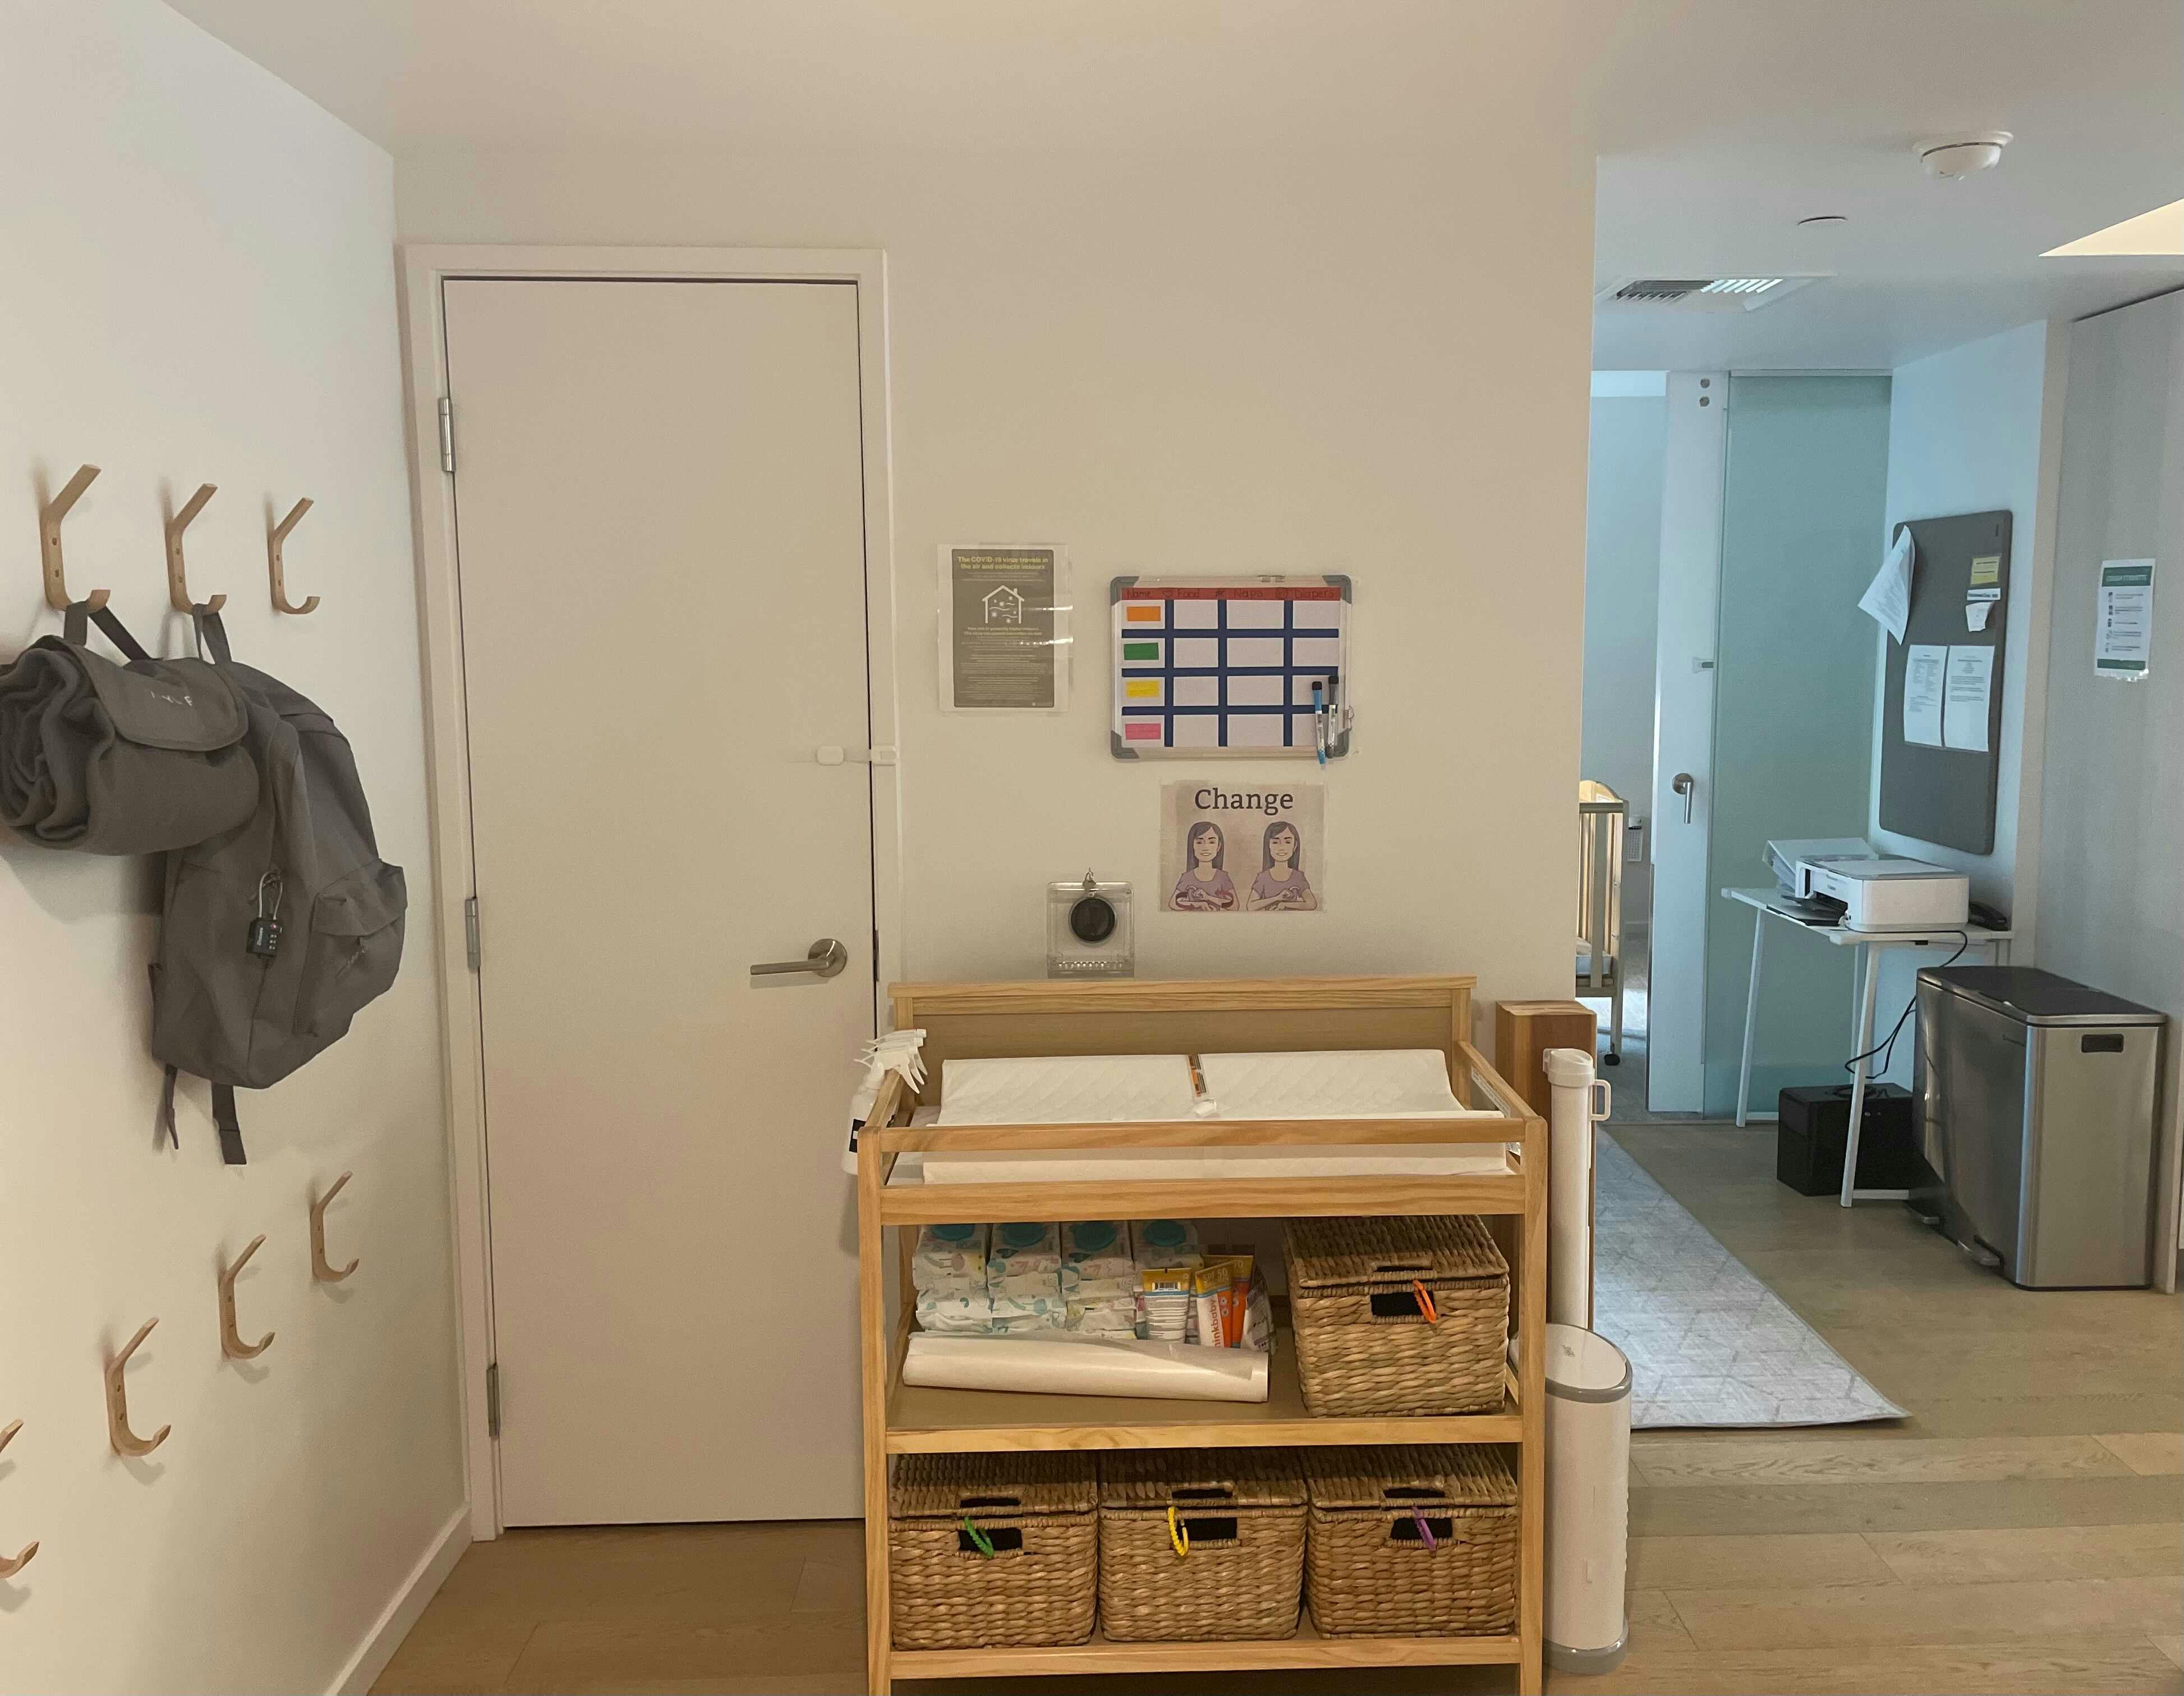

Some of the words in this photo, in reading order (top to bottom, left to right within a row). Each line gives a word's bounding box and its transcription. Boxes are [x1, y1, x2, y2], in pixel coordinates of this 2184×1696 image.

[1127, 589, 1151, 598] Name
[1177, 588, 1200, 598] Food
[1234, 589, 1263, 599] Naps
[1294, 589, 1335, 599] Diapers
[1194, 787, 1293, 816] Change
[1217, 1267, 1228, 1278] 50
